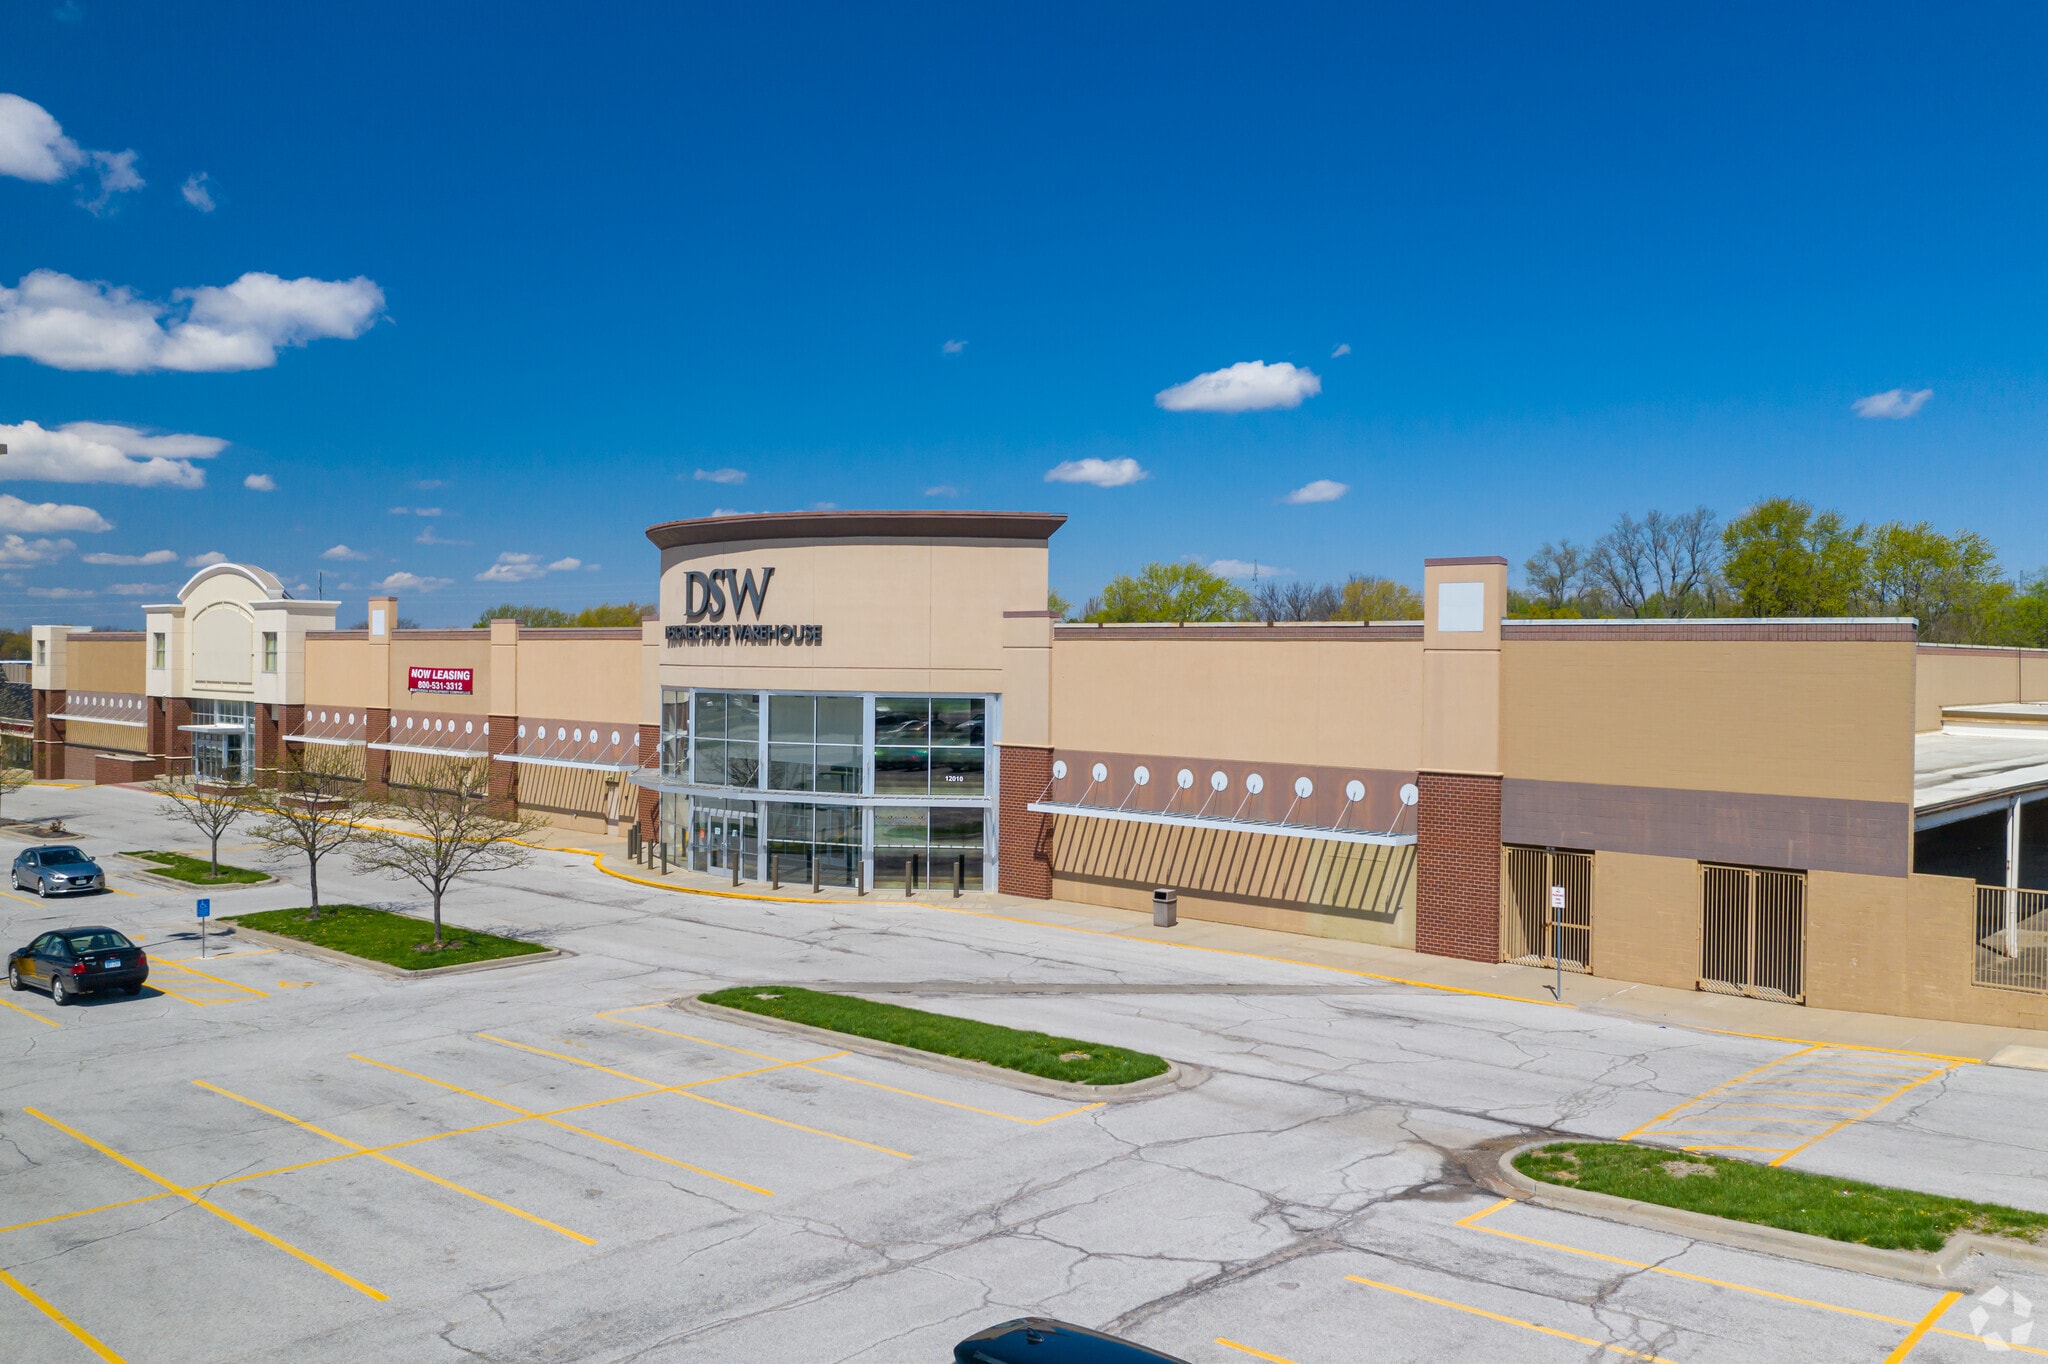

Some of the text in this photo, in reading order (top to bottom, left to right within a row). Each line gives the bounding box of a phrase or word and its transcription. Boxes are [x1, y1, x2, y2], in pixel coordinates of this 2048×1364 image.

[683, 567, 775, 621] DSW
[701, 624, 731, 640] SHOE
[732, 624, 822, 641] WAREHOUSE
[411, 668, 470, 680] NOW LEASING
[418, 680, 463, 690] 800-531-3312
